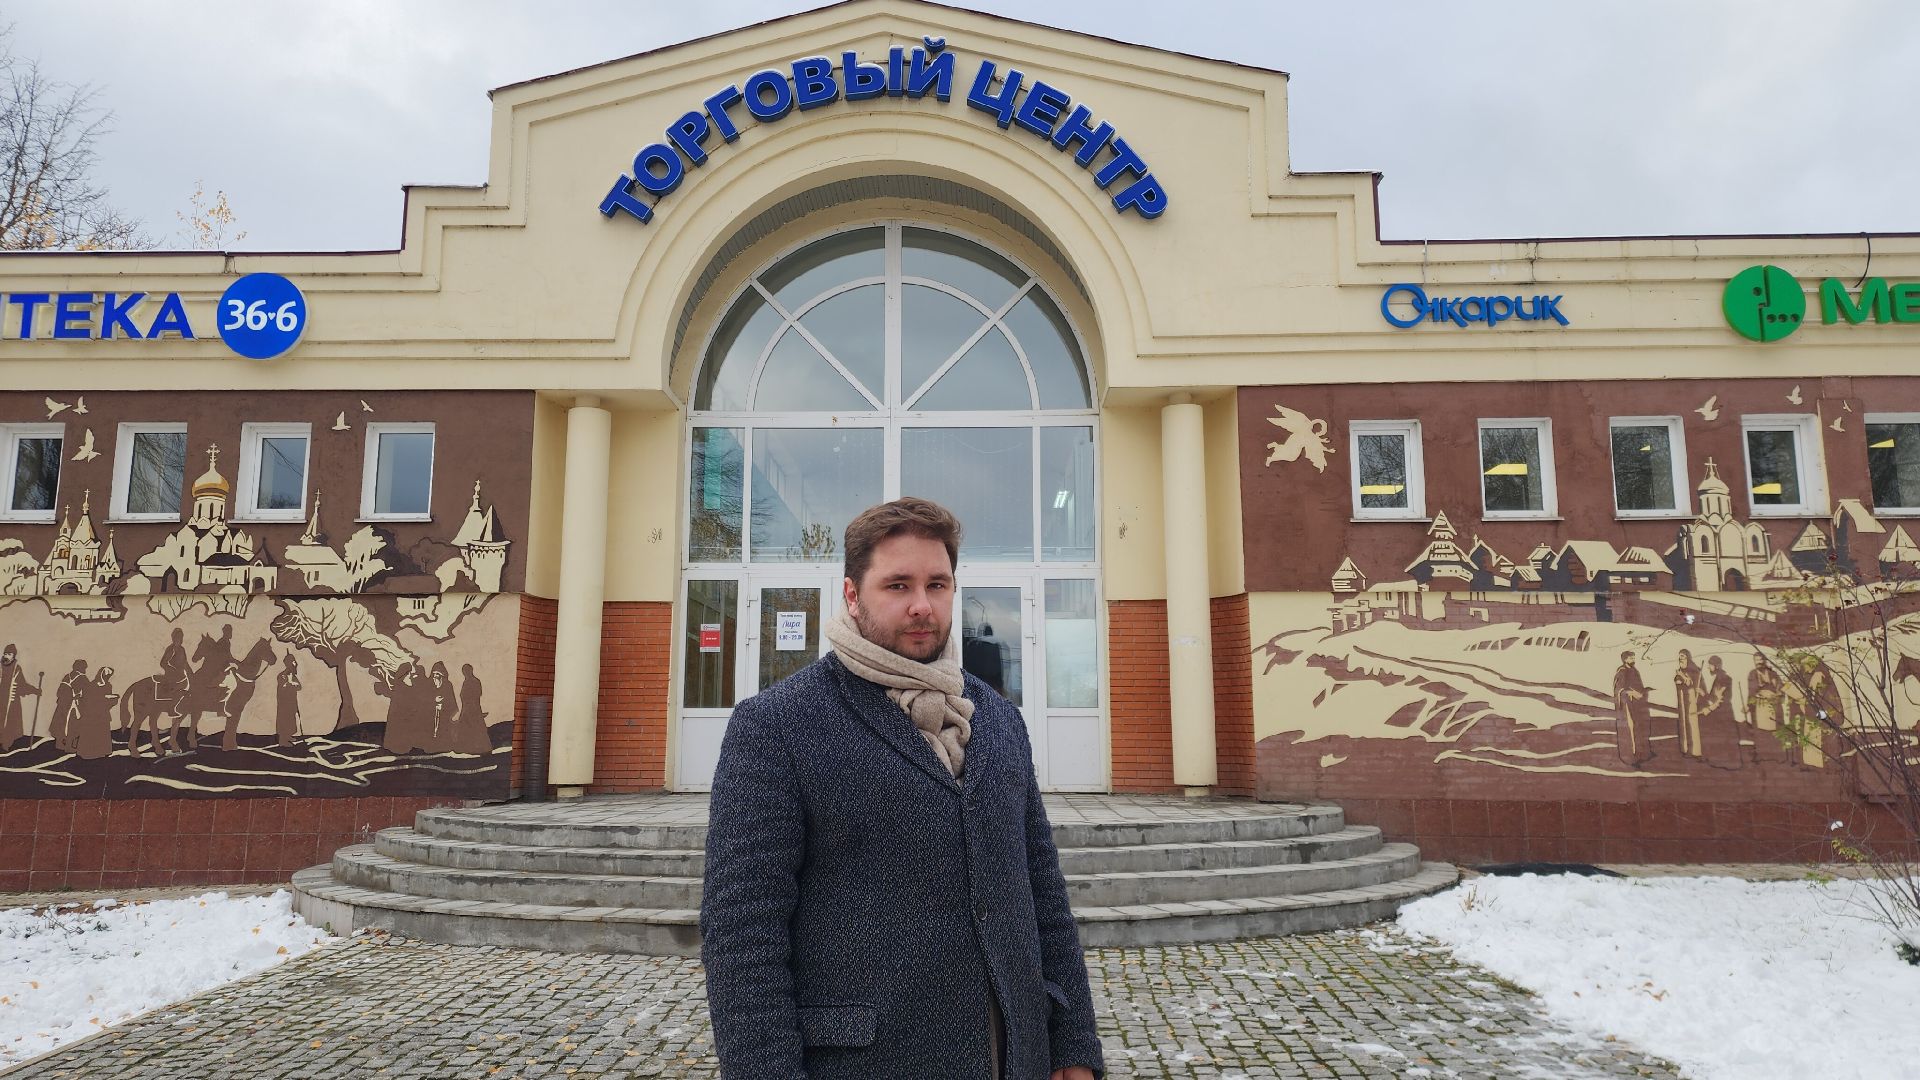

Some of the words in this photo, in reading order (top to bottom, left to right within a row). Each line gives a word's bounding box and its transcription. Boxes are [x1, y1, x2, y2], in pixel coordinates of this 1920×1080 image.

[599, 36, 956, 224] ТОРГОВЫЙ
[967, 61, 1168, 220] ЦЕНТР
[0, 292, 197, 340] ТЕКА
[1381, 284, 1570, 328] Очкарик
